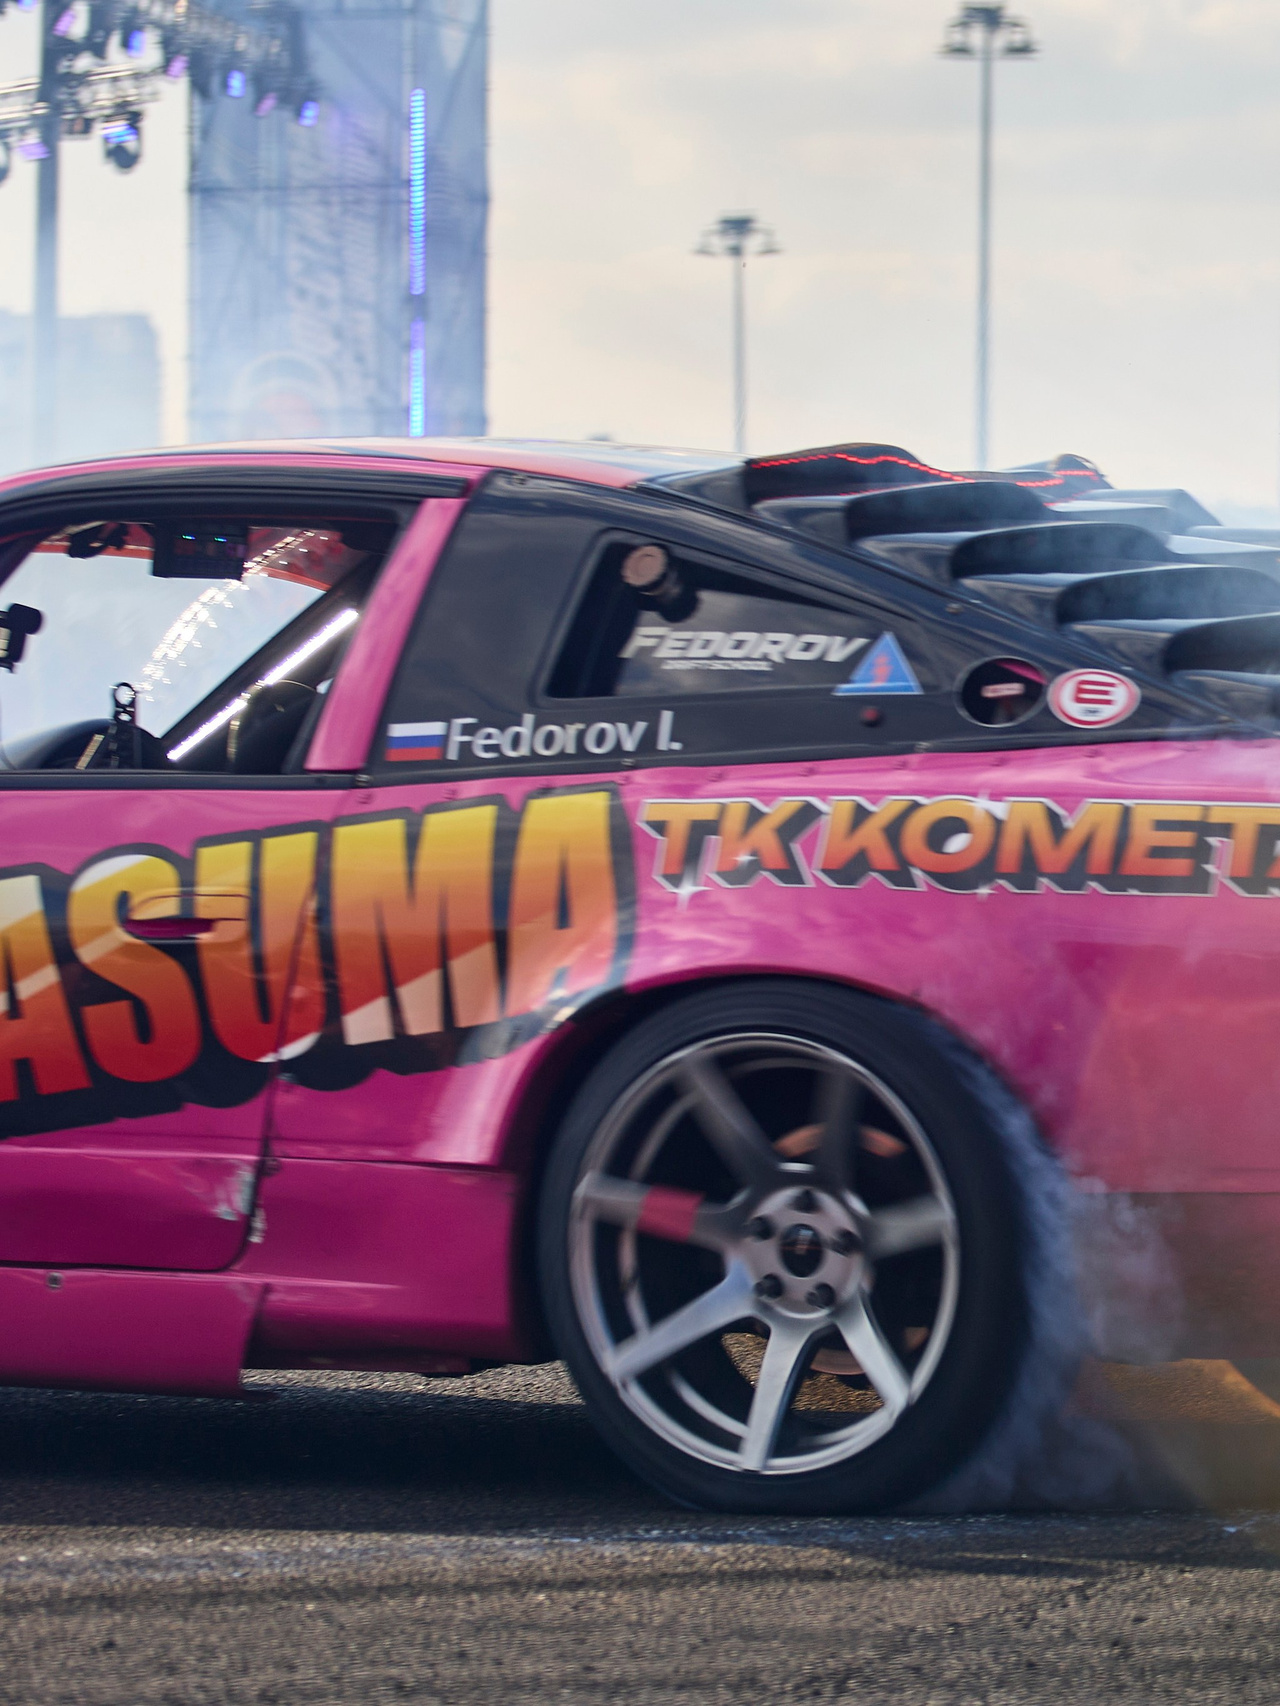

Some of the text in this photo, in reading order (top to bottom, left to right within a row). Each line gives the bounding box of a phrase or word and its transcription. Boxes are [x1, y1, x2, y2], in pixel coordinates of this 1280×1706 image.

[618, 626, 871, 663] FEDOROV
[446, 712, 649, 761] Fedorov
[641, 799, 812, 880] TK
[0, 788, 628, 1110] ASUMA
